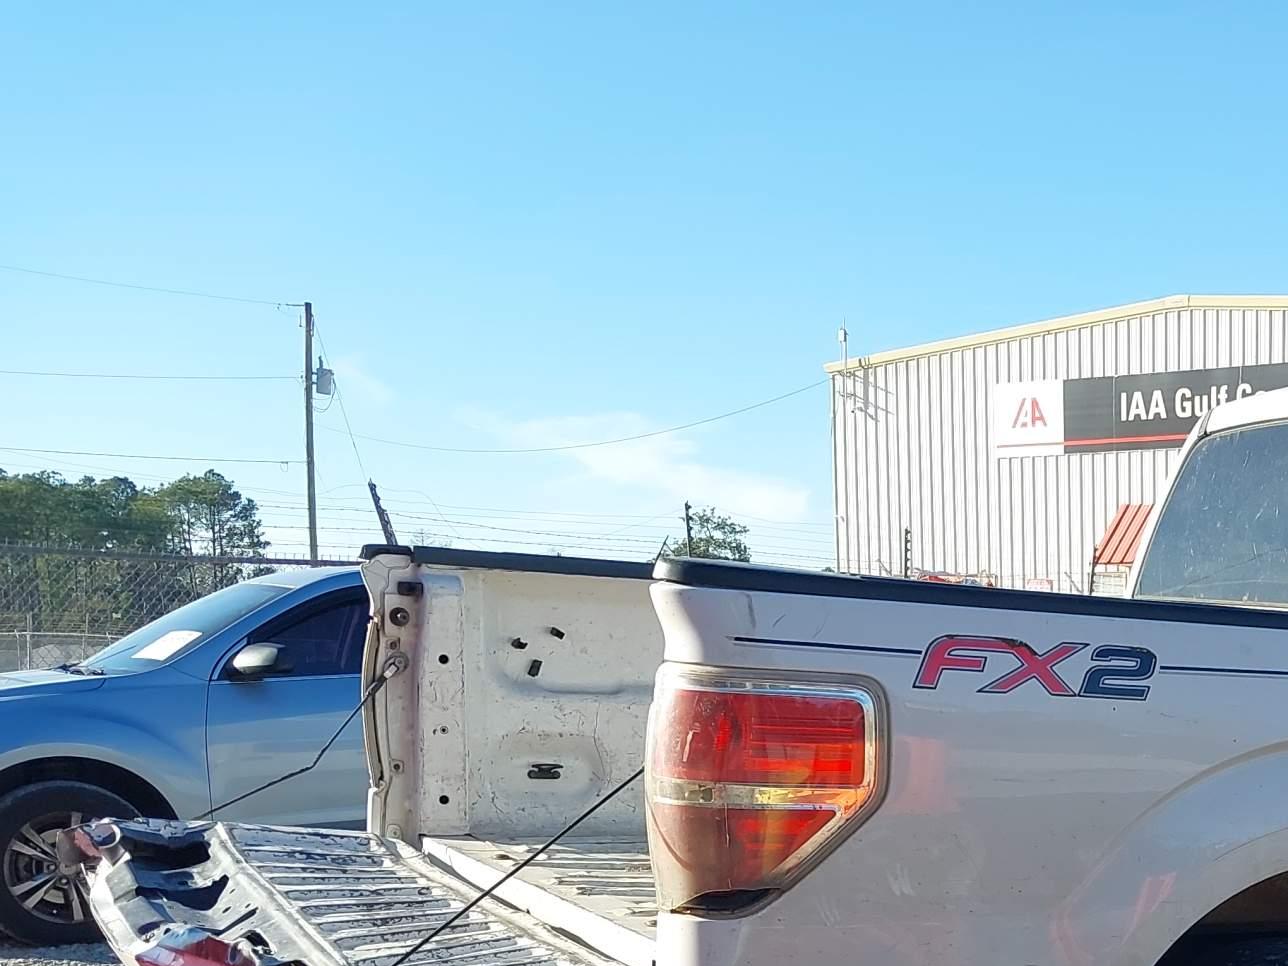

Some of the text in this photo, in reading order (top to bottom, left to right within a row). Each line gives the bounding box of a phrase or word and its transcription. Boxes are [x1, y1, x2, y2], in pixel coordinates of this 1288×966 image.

[1120, 390, 1167, 421] IAA
[1175, 385, 1229, 419] Gulf
[912, 633, 1157, 701] FX2
